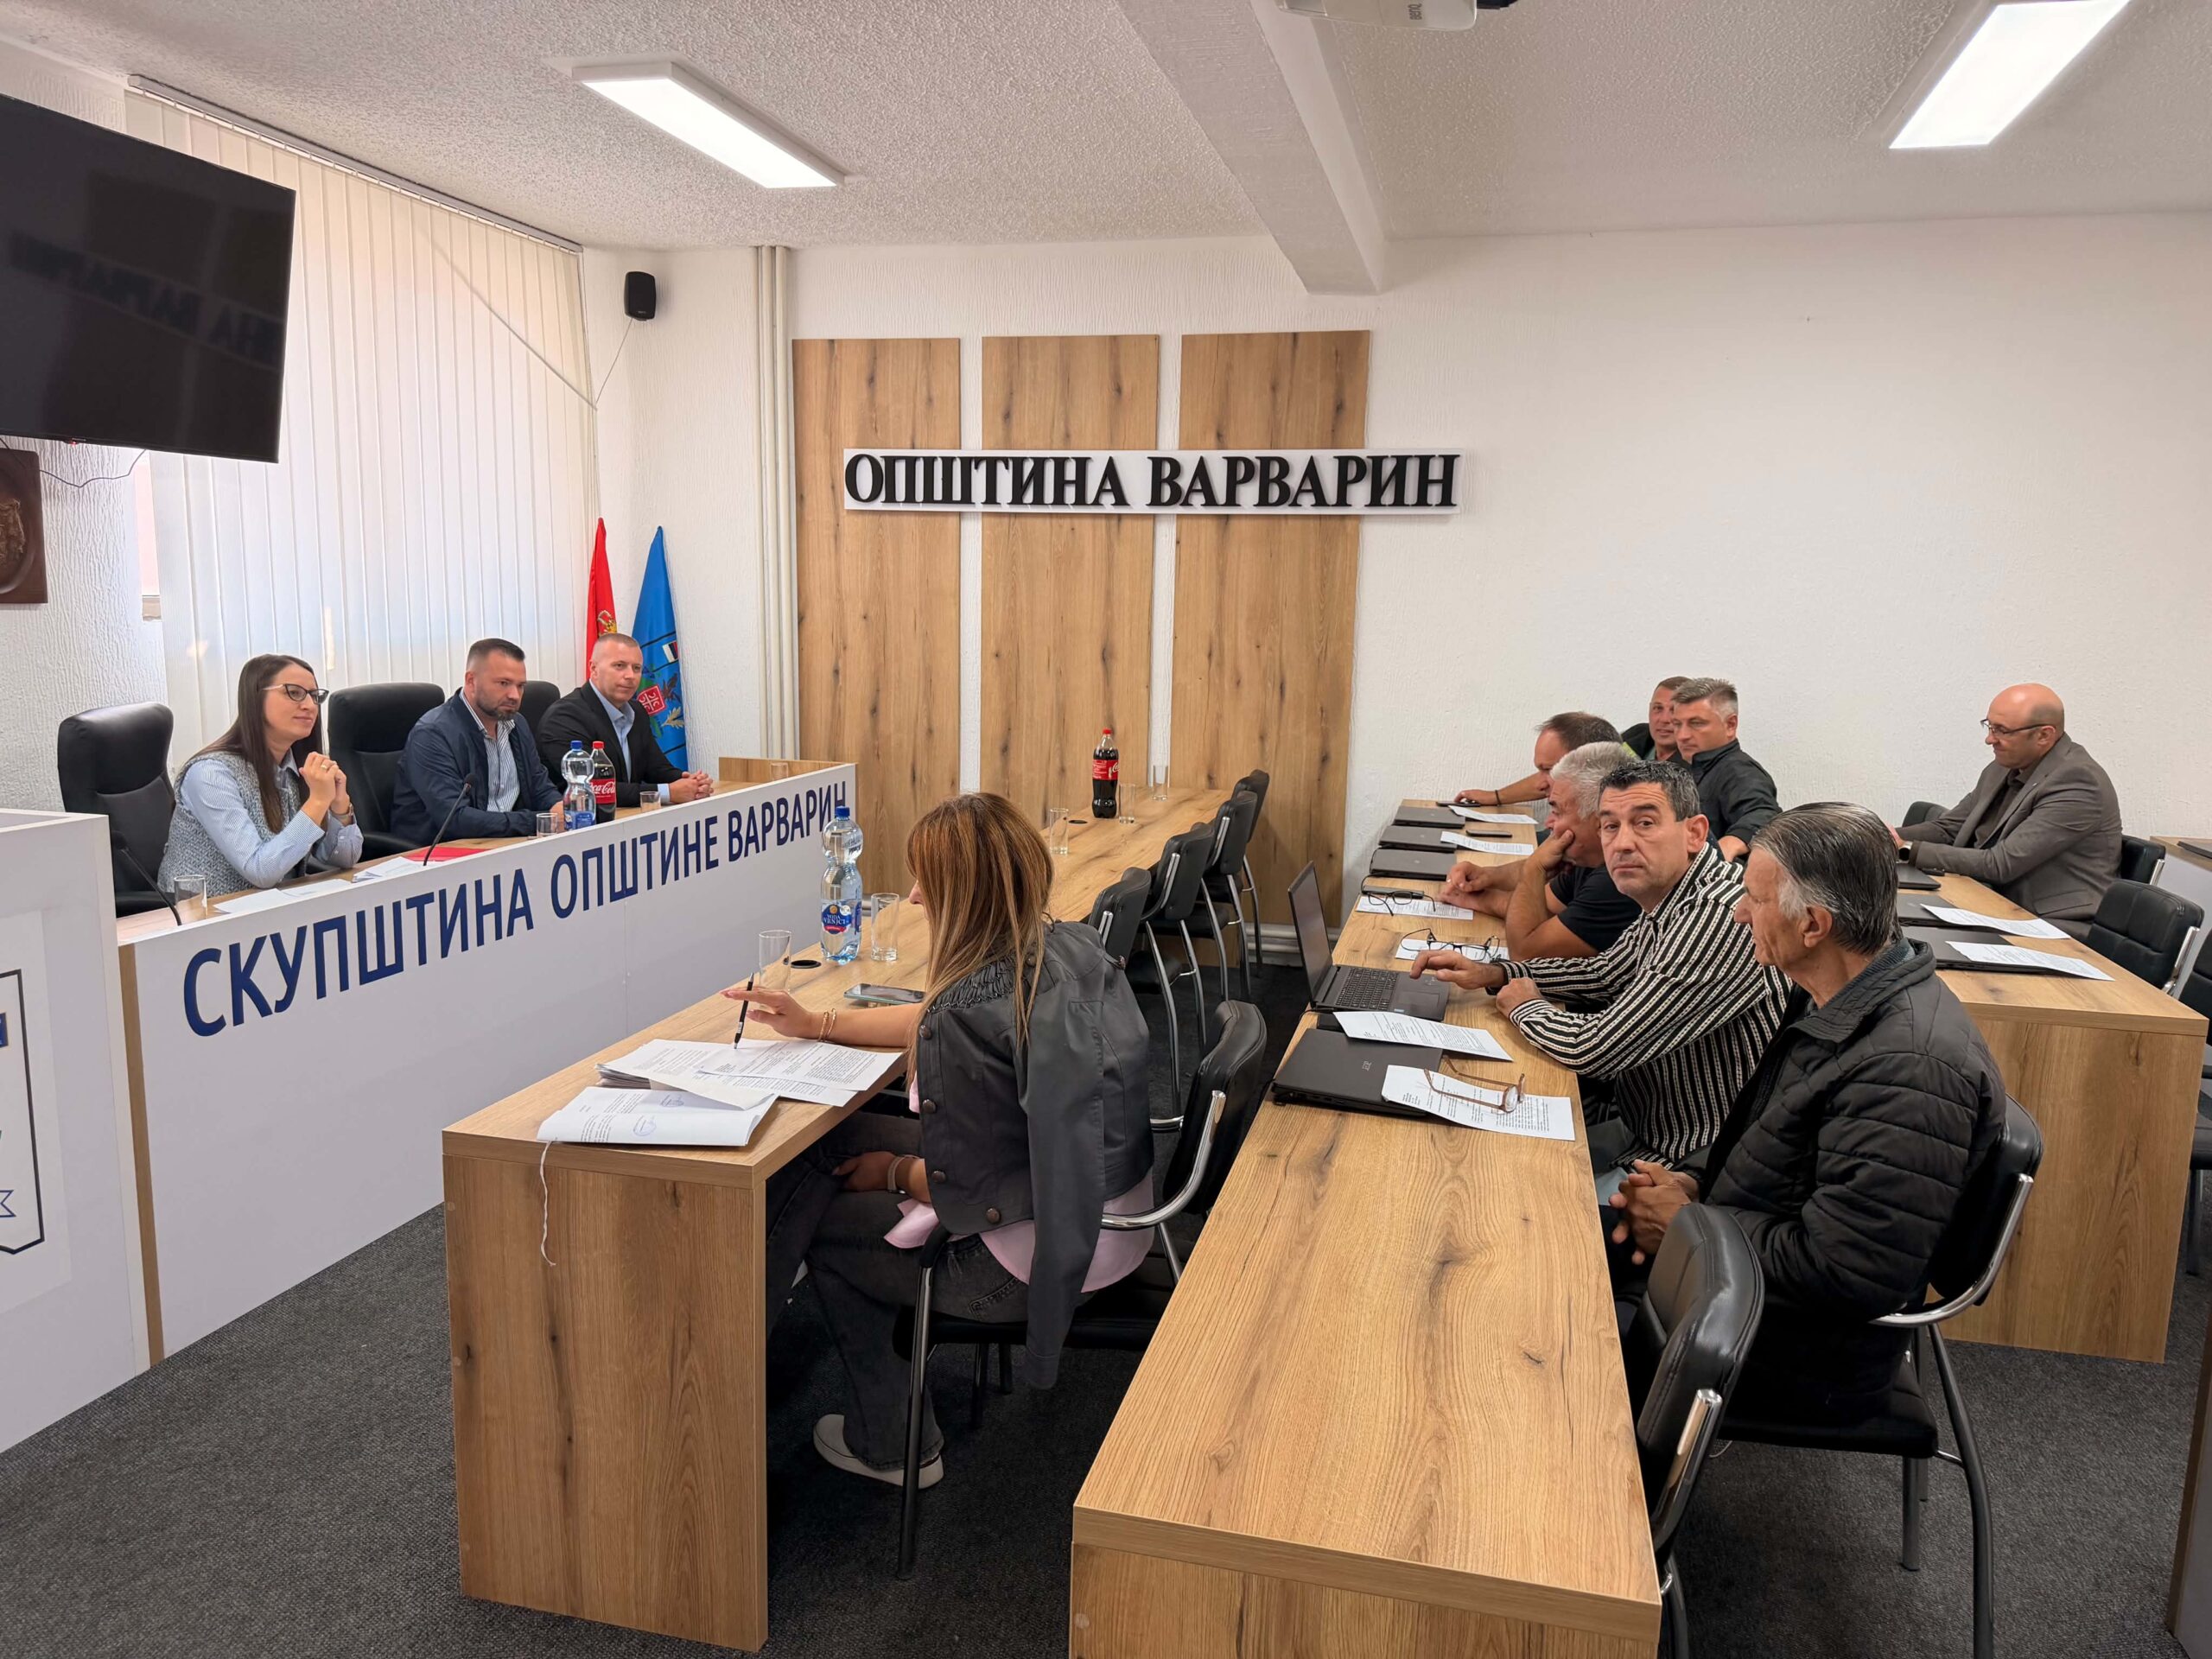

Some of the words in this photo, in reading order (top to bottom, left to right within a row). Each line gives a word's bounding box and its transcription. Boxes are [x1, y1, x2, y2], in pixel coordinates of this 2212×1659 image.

[844, 454, 1131, 507] ОПШТИНА
[1146, 454, 1461, 508] ВАРВАРИН
[183, 868, 534, 1037] СКУПШТИНА
[550, 815, 719, 919] ОПШТИНЕ
